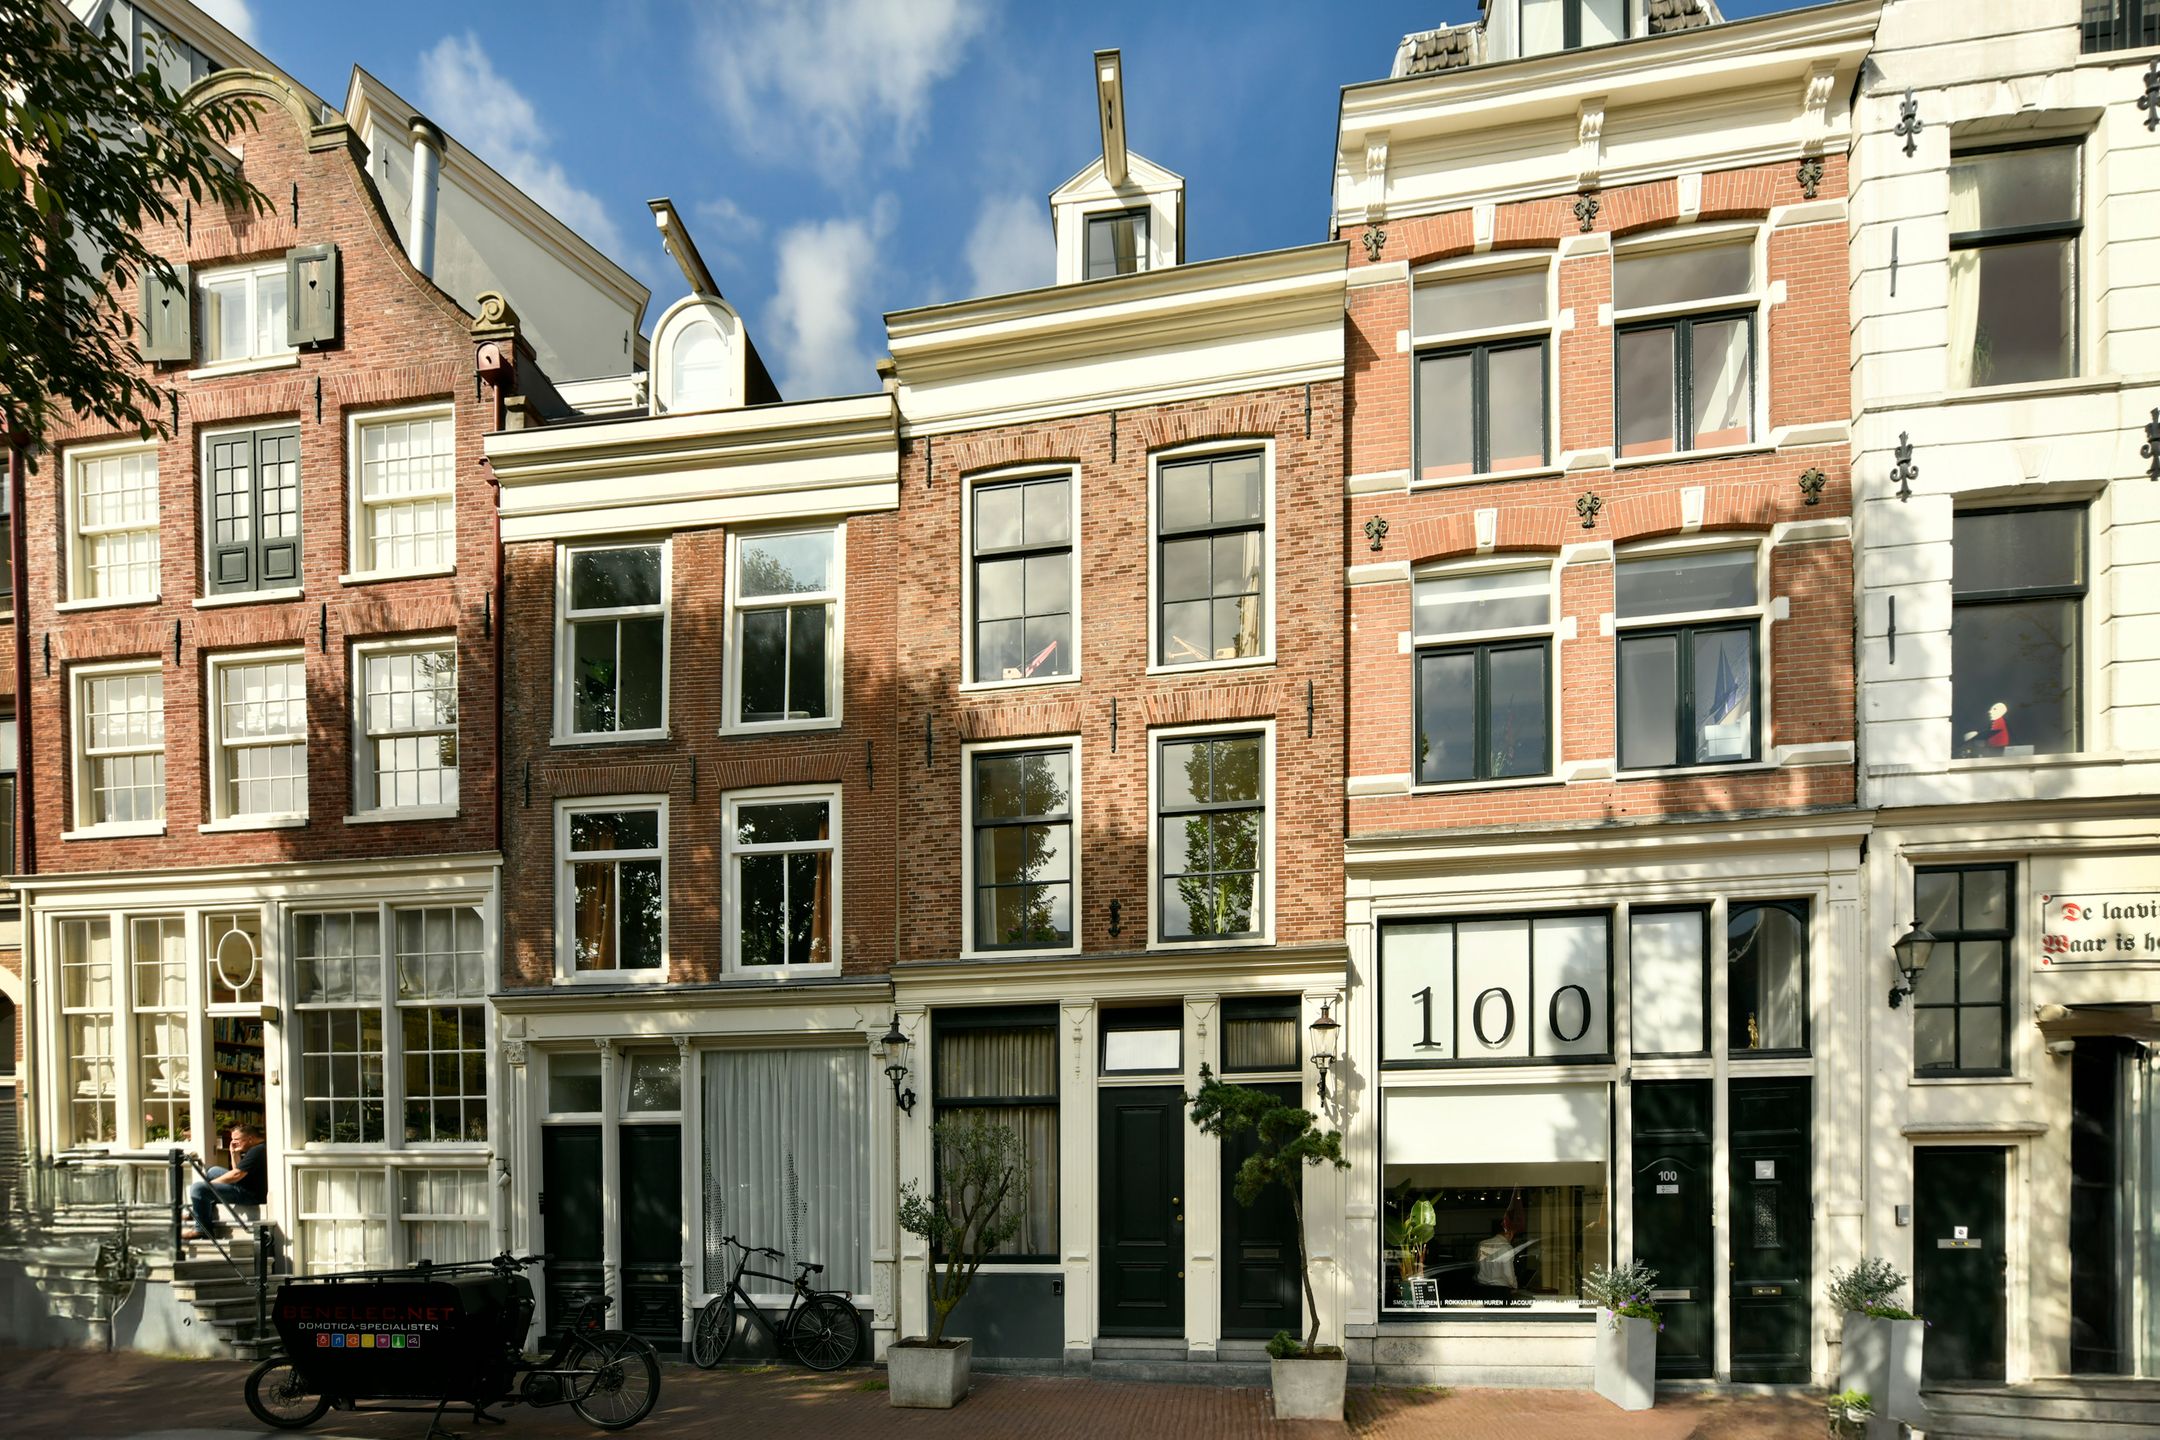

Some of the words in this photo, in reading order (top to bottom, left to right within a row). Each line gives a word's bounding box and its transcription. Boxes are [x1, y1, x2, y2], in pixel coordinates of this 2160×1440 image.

[2103, 900, 2160, 920] laavi
[2042, 934, 2107, 954] Waar
[2116, 933, 2136, 951] is
[1412, 984, 1591, 1047] 100
[1658, 1170, 1678, 1182] 100
[283, 1305, 455, 1321] BENELEC.NET
[298, 1322, 439, 1331] DOMOTICA-SPECIALISTEN
